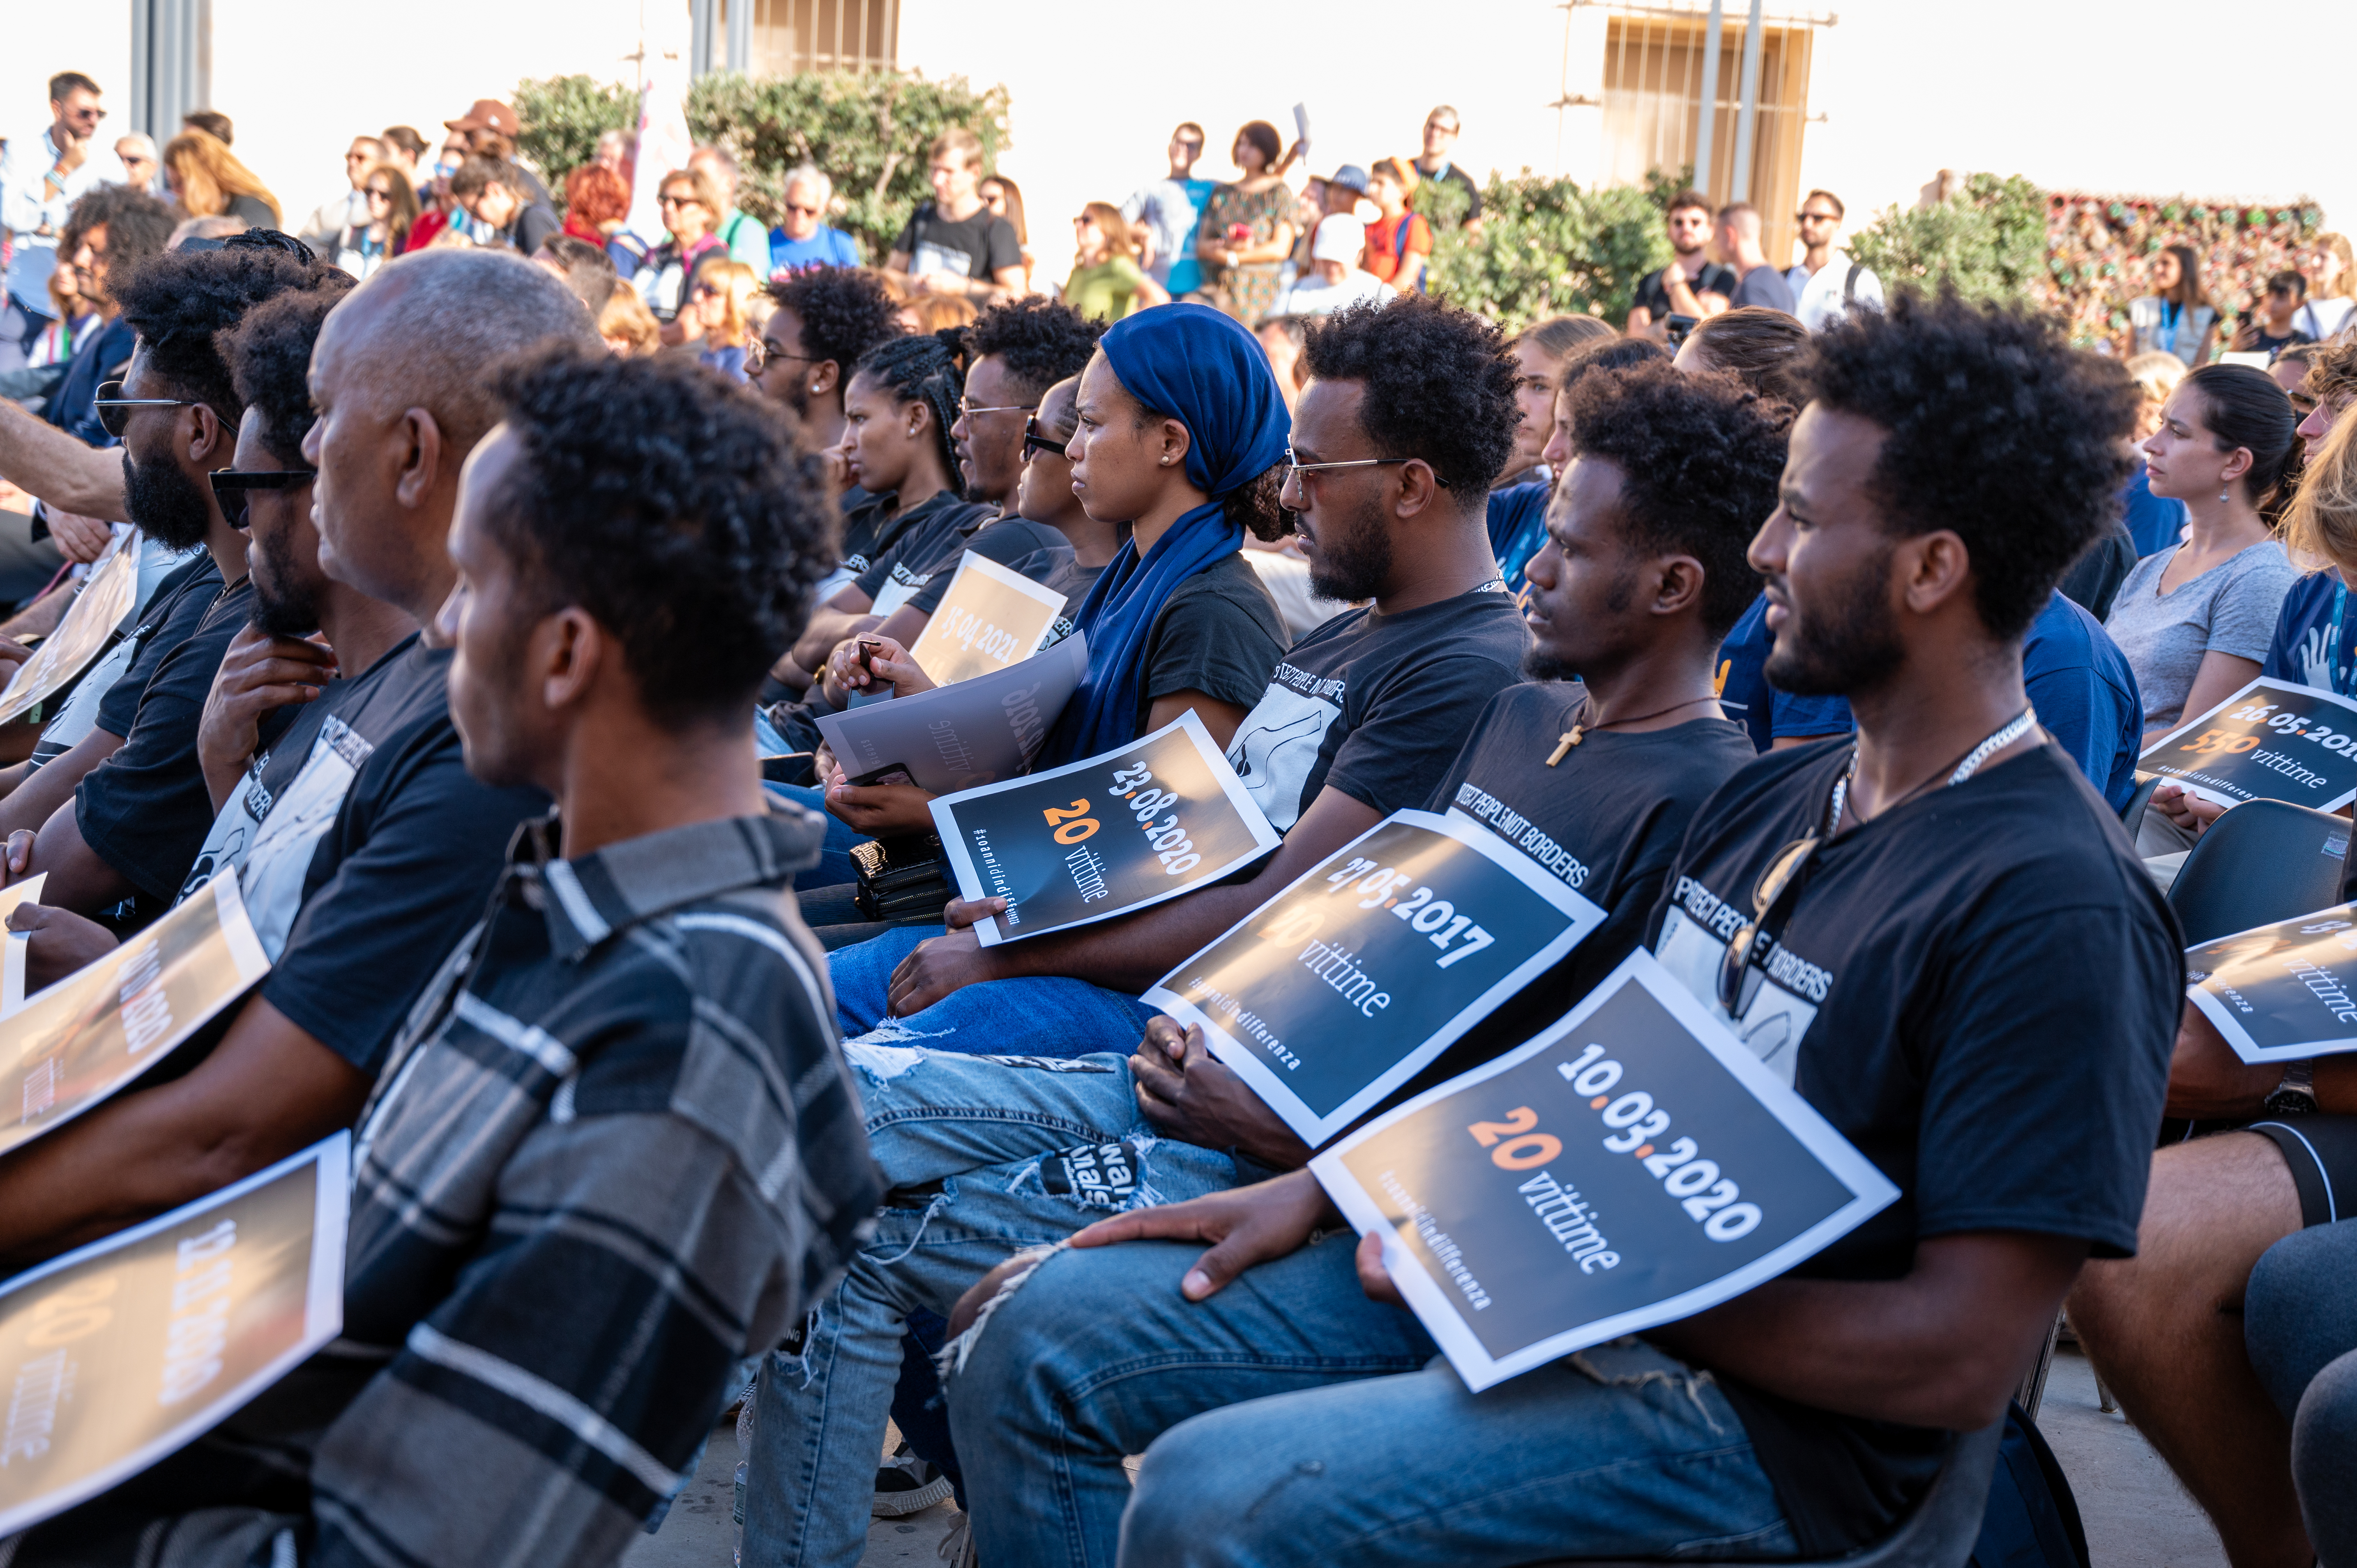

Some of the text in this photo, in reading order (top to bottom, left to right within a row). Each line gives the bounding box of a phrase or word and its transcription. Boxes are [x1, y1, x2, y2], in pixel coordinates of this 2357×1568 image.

[2179, 729, 2327, 789] 550 vittime
[2229, 705, 2357, 763] 26.05.201
[1043, 798, 1109, 903] 20 vittime
[1109, 761, 1201, 875] 23.08.2020
[1470, 792, 1511, 829] PEOPLE
[1500, 810, 1532, 840] NOT
[1519, 826, 1589, 889] BORDERS
[1327, 857, 1496, 970] 27.05.2017
[1297, 939, 1391, 1018] vittime
[1098, 1143, 1136, 1207] wal
[1467, 1106, 1621, 1275] 20 vittime
[1557, 1043, 1763, 1243] 10.03.2020
[783, 1327, 800, 1343] NG
